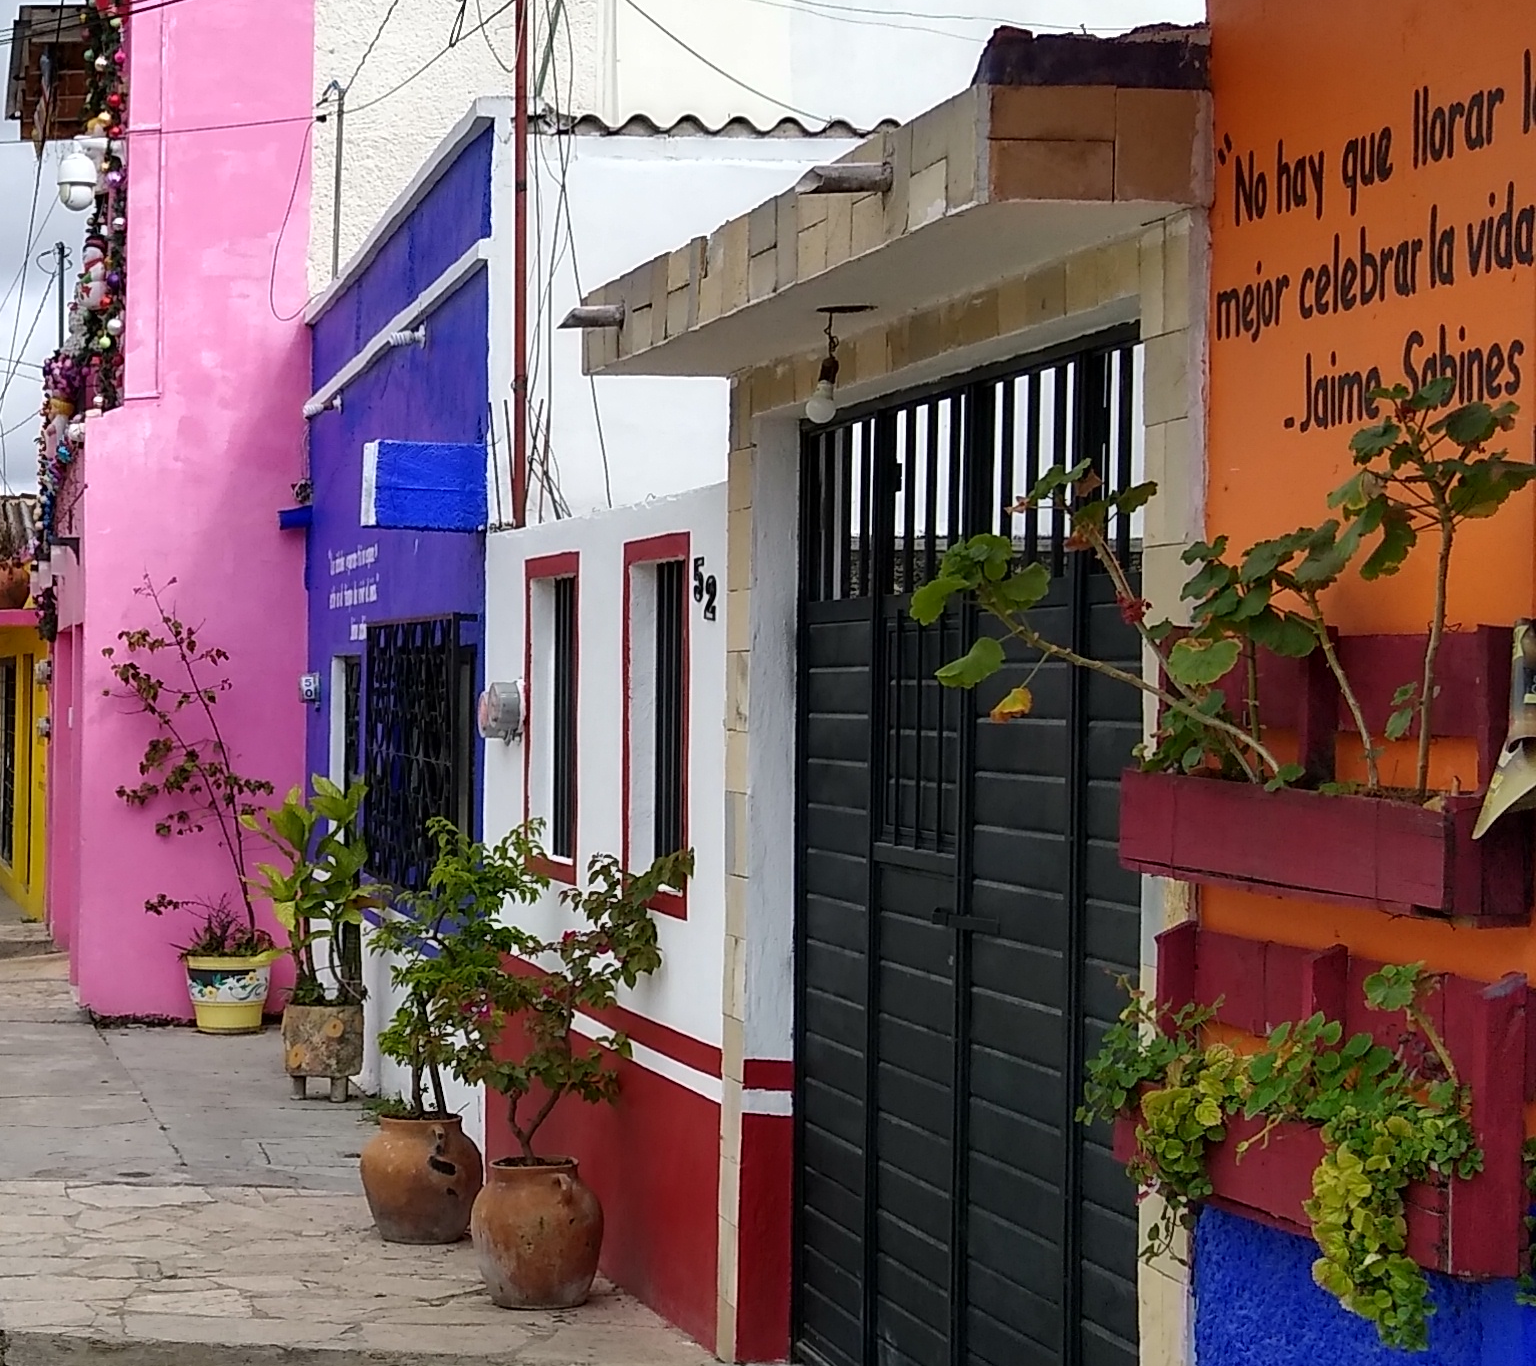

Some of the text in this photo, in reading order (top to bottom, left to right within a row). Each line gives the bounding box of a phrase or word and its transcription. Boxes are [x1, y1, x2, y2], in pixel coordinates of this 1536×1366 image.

[1276, 138, 1325, 221] hay
[1342, 126, 1394, 217] que
[1413, 85, 1505, 170] llorar
[1216, 180, 1536, 343] mejor celebrar la vida
[693, 556, 718, 622] 52
